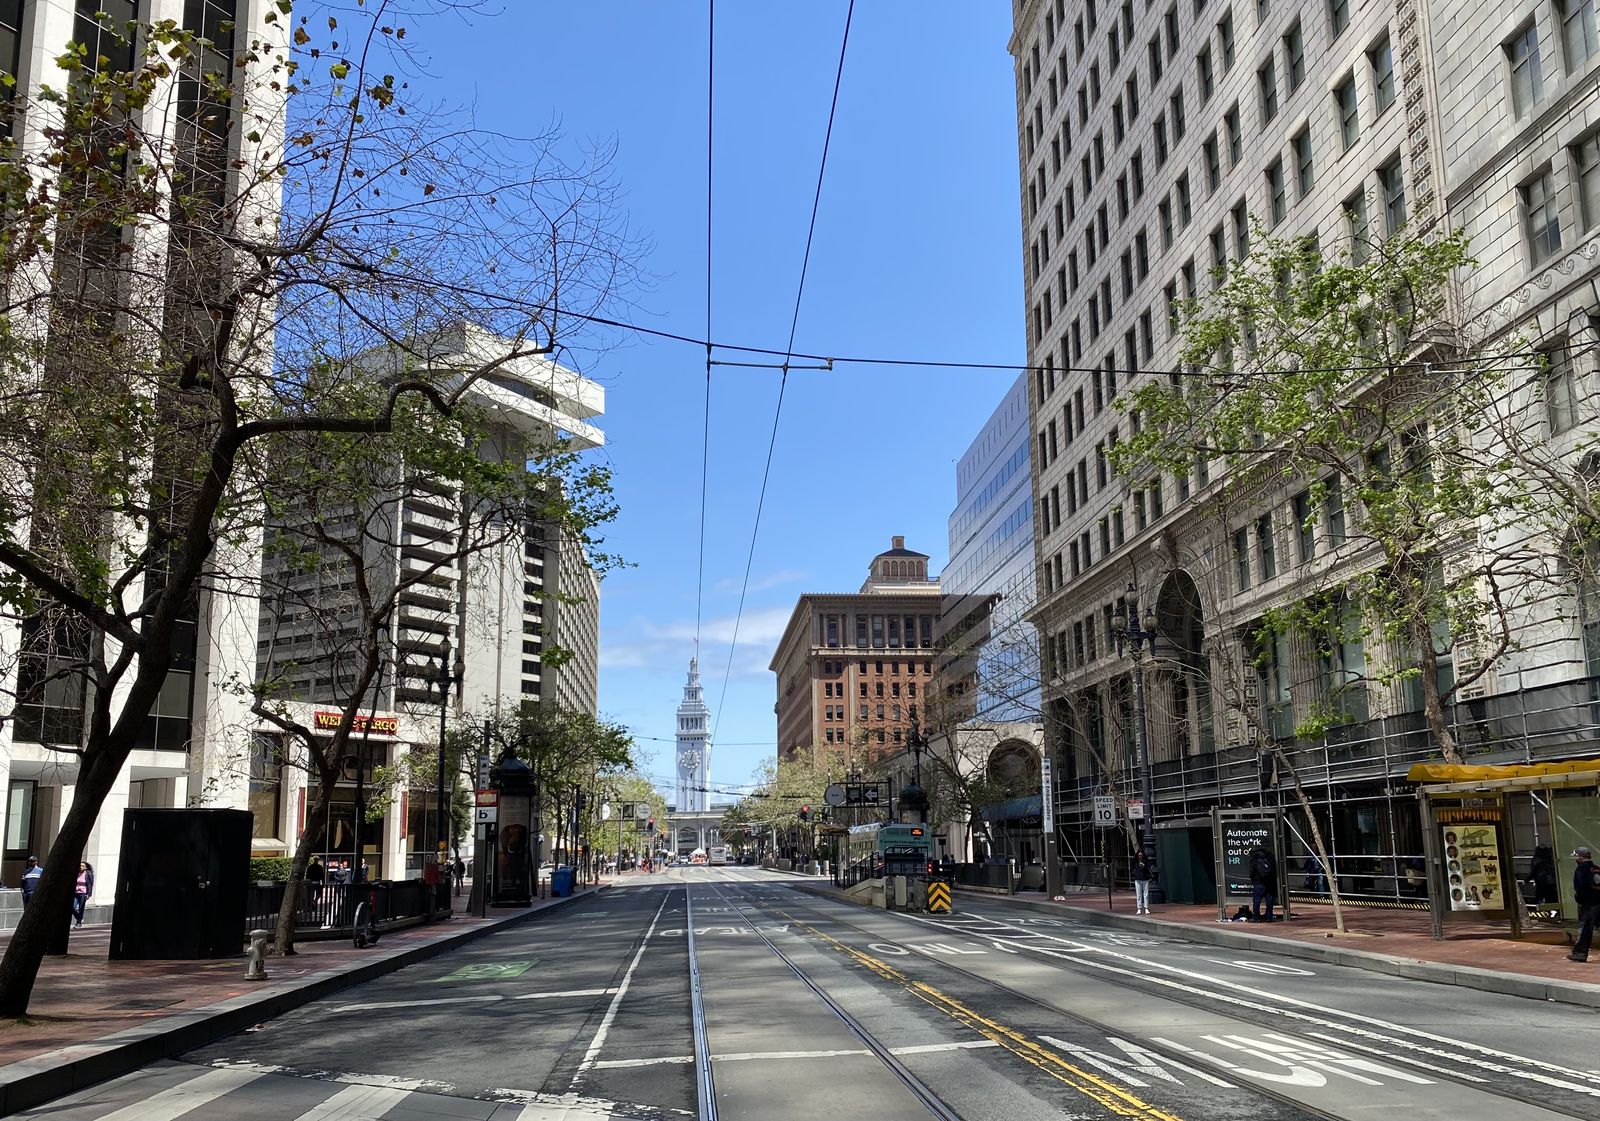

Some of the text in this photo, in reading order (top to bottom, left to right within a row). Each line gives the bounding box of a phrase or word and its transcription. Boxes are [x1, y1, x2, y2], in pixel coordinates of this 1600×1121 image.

[318, 714, 357, 728] WELS
[1099, 810, 1111, 819] 10
[1228, 857, 1241, 865] HR
[660, 924, 789, 937] AHEAD
[868, 942, 1019, 955] ONLY
[1037, 1032, 1491, 1088] MUNI
